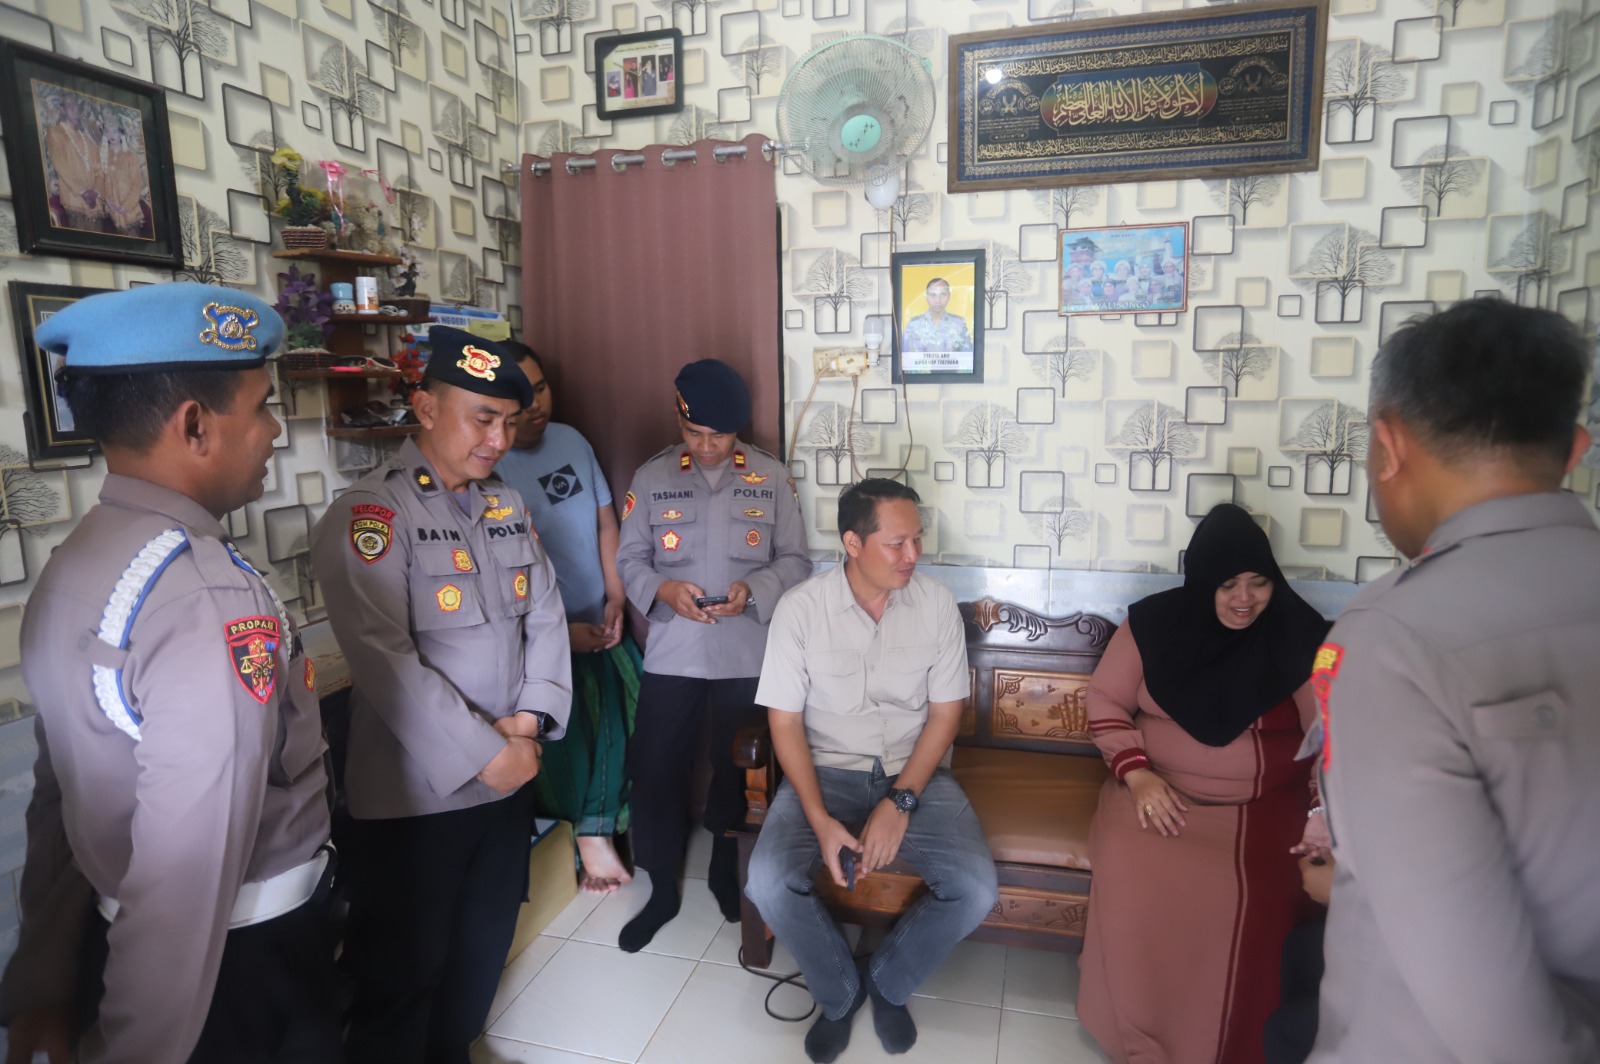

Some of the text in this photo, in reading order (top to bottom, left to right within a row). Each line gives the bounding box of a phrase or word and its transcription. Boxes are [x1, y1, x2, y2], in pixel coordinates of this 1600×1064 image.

[1092, 301, 1149, 310] WALISONGO
[652, 490, 694, 501] TASMANI
[733, 488, 773, 499] POLRI
[354, 505, 393, 519] PELOPOR
[417, 528, 461, 541] BAIN
[230, 620, 274, 634] PROPAM
